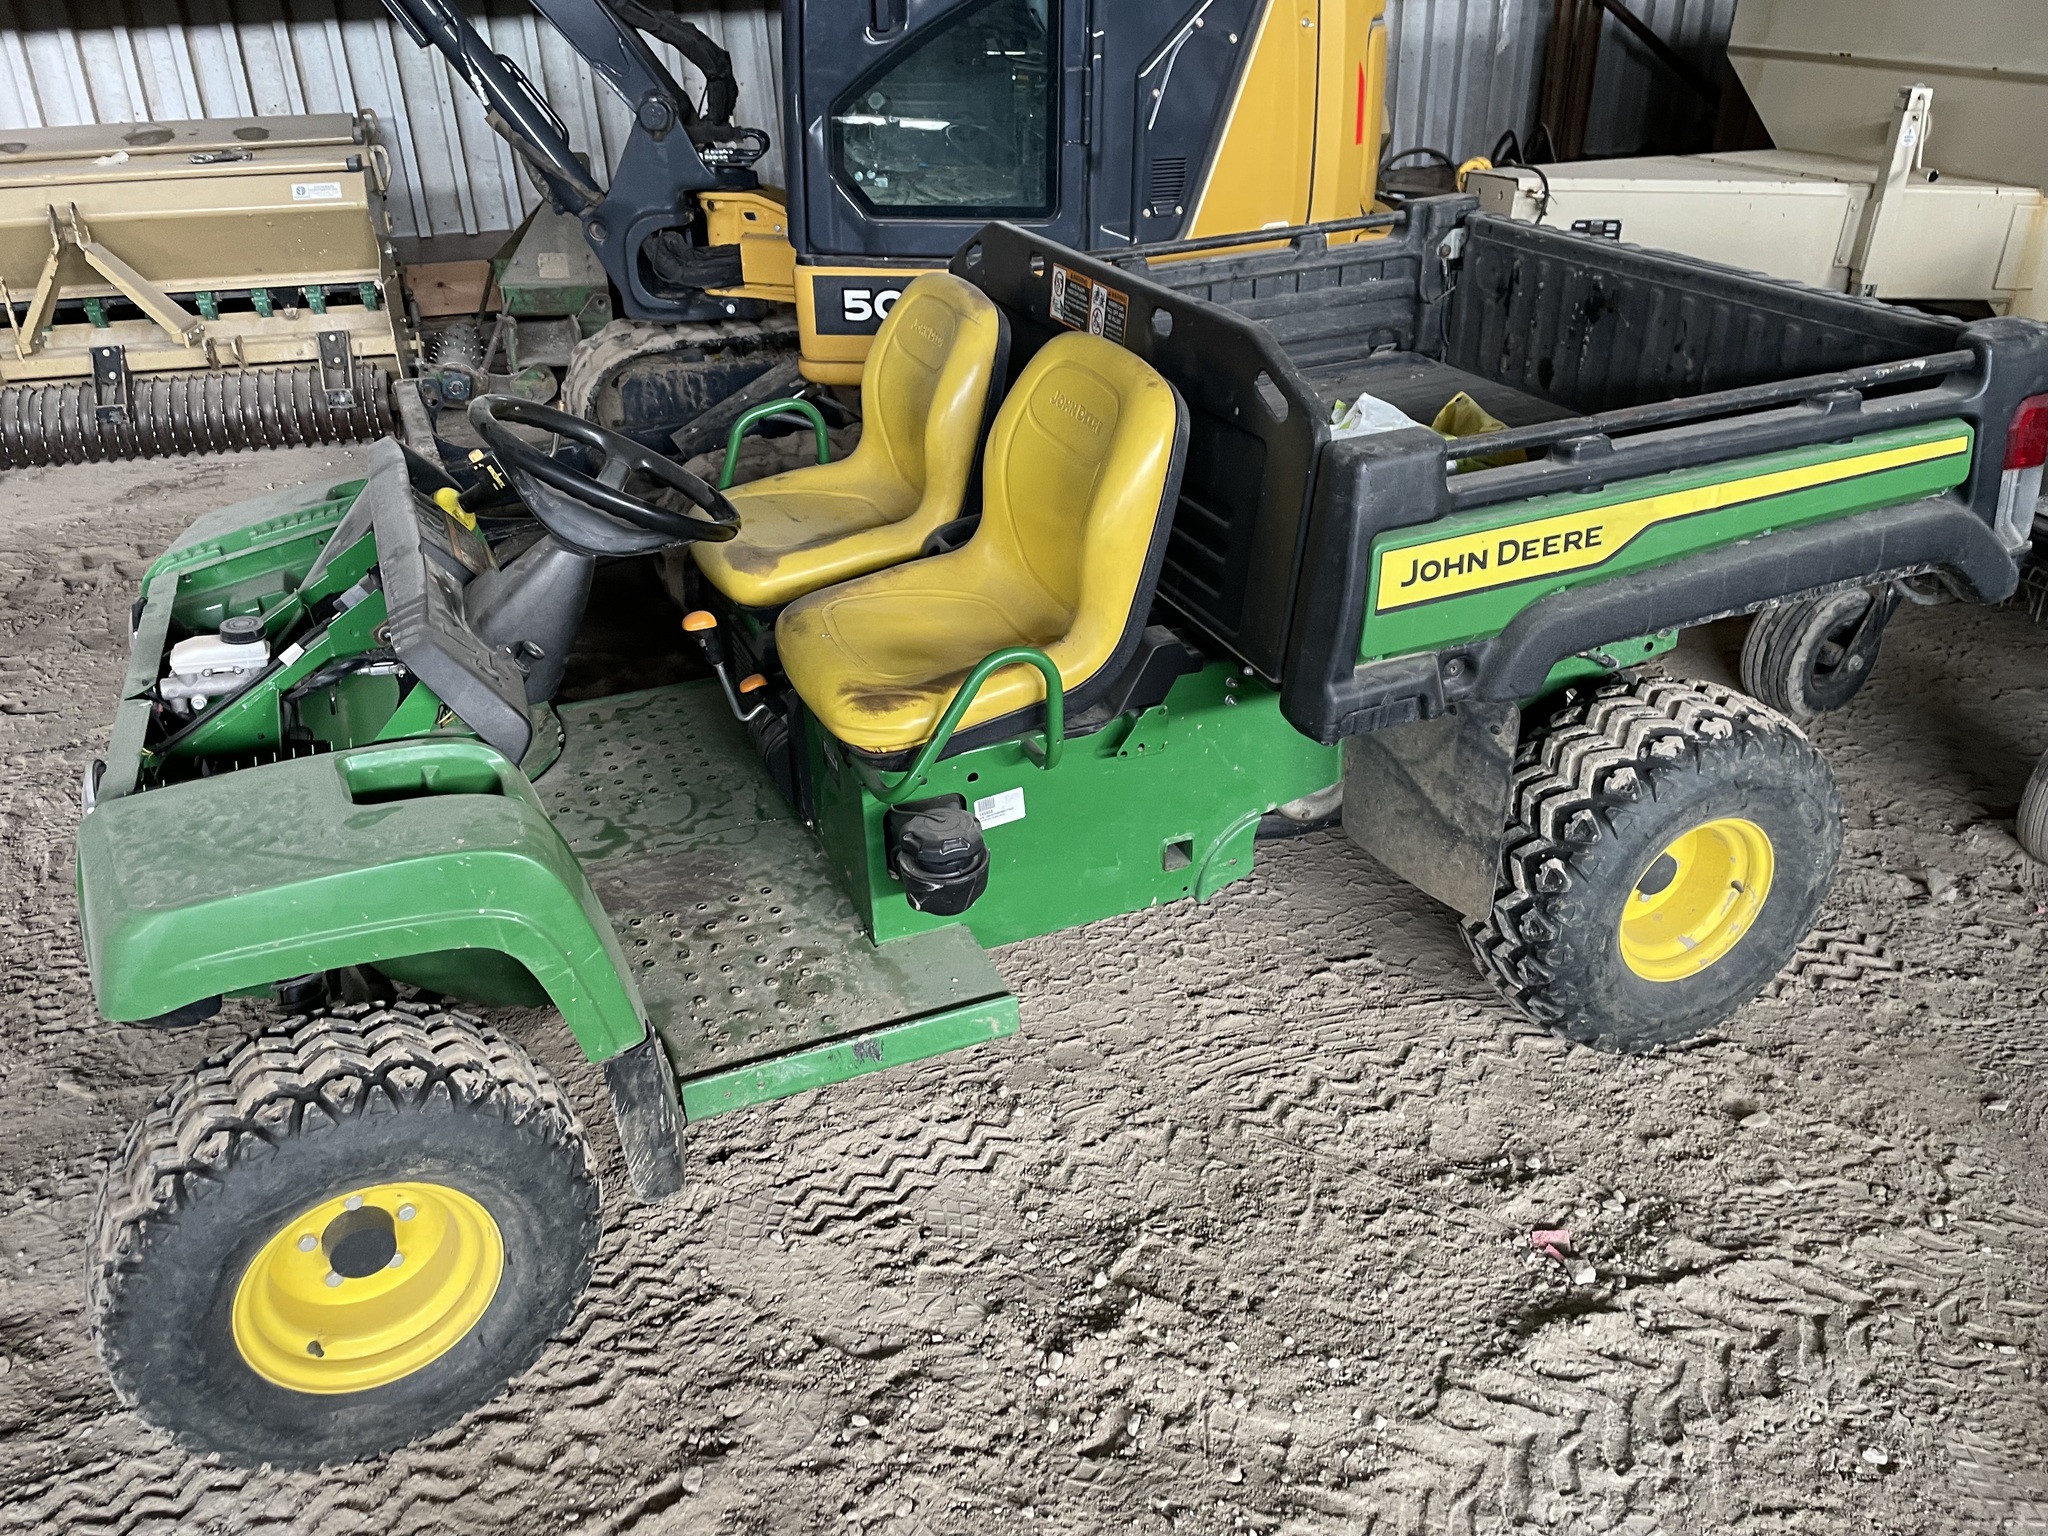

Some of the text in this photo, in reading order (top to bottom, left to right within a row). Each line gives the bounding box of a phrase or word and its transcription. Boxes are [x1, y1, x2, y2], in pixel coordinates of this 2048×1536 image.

[1050, 389, 1077, 418] JOHN
[1401, 526, 1603, 587] JOHN DEERE
